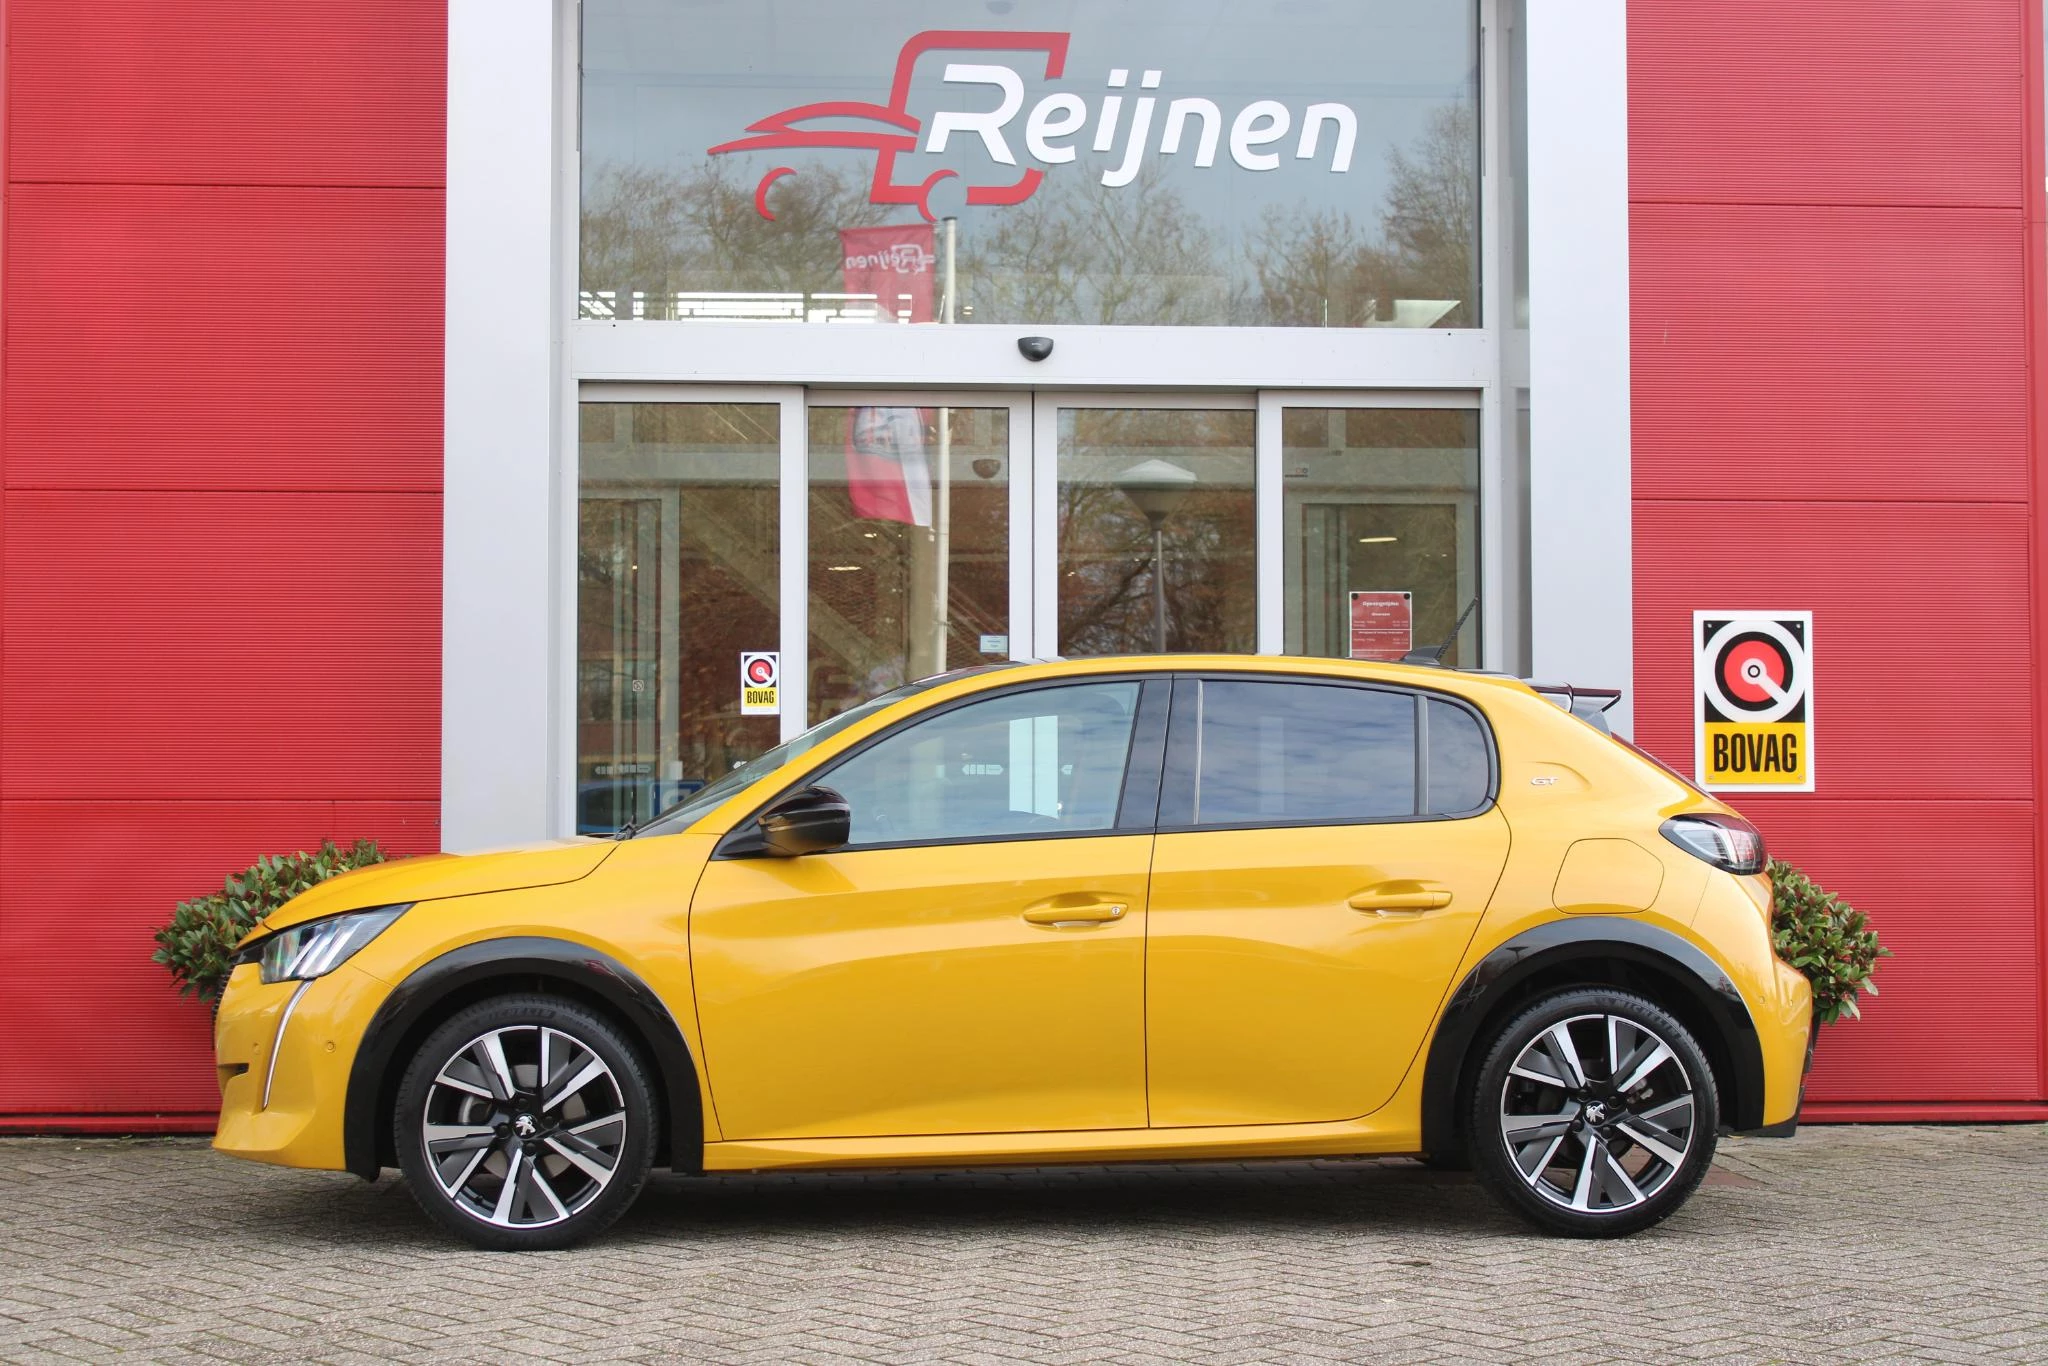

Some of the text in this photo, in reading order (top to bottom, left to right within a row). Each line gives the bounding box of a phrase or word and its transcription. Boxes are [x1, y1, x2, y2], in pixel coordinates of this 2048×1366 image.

[925, 63, 1358, 188] Reijnen
[747, 690, 775, 704] BOVAG
[1713, 733, 1797, 773] BOVAG
[1531, 776, 1559, 786] GT
